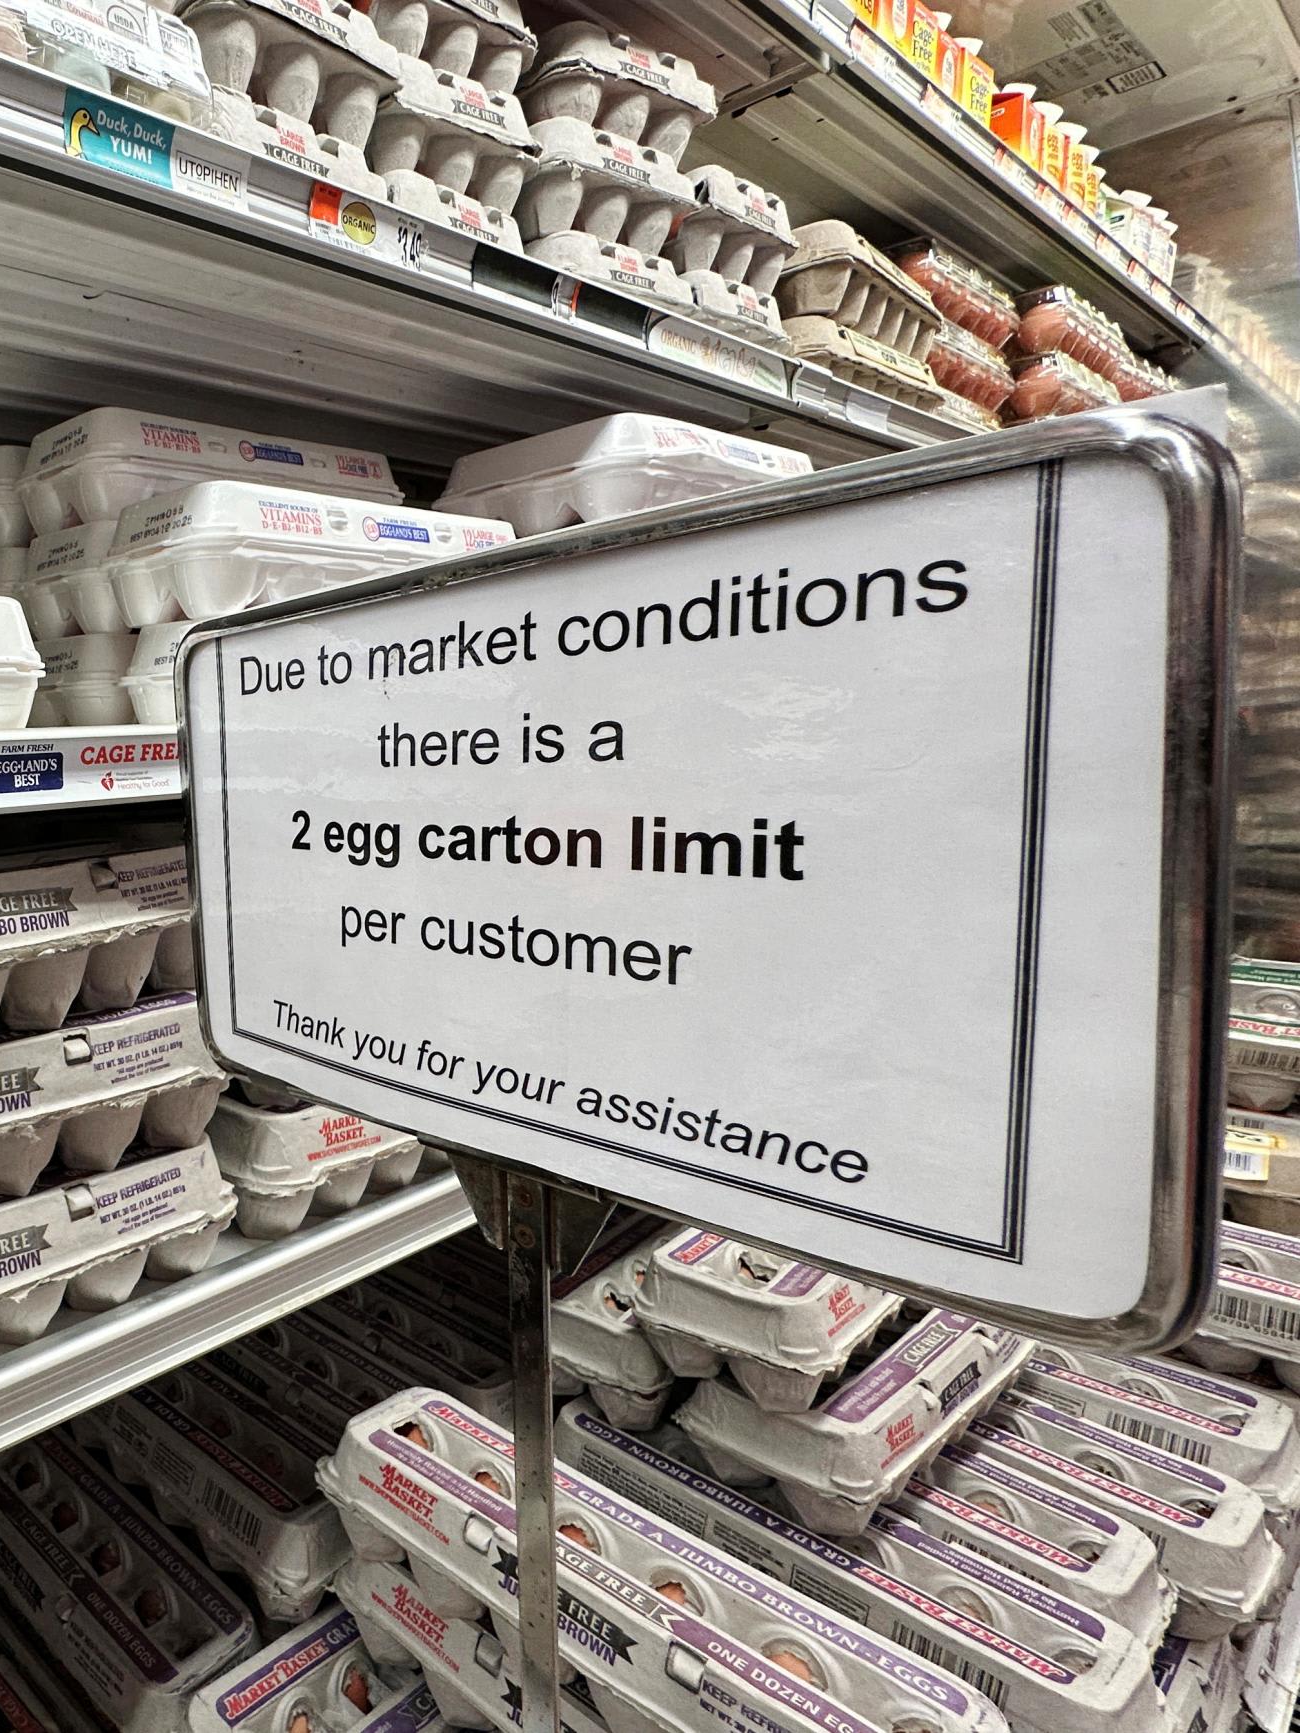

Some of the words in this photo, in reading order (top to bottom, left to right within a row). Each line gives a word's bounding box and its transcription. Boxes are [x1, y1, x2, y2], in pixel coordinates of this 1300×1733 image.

[52, 19, 94, 46] OPEN
[96, 109, 131, 138] Duck,
[134, 122, 167, 150] Duck,
[110, 135, 152, 164] YUM!
[273, 147, 300, 167] CAGE
[301, 158, 323, 176] FREE
[178, 155, 239, 193] UTOPIHEN
[609, 160, 628, 175] CAGE
[629, 167, 645, 180] FREE
[343, 214, 375, 235] ORGANIC
[616, 271, 634, 284] CAGE
[635, 276, 650, 288] FREE
[142, 427, 200, 447] VITAMINS
[260, 508, 322, 526] VITAMINS
[240, 655, 304, 695] Due
[318, 643, 352, 685] to
[369, 612, 537, 680] market
[557, 558, 967, 658] conditions
[1, 745, 25, 754] FARM
[27, 743, 54, 753] FRESH
[80, 745, 135, 766] CAGE
[378, 722, 499, 768] there
[522, 712, 564, 764] is
[588, 719, 625, 763] a
[14, 773, 41, 788] BEST
[291, 811, 311, 851] 2
[324, 823, 400, 869] egg
[417, 816, 601, 869] carton
[631, 817, 804, 881] limit
[18, 891, 58, 912] FREE
[19, 910, 70, 933] BROWN
[341, 905, 405, 948] per
[420, 914, 691, 985] customer
[273, 1000, 345, 1048] Thank
[354, 1032, 406, 1067] you
[415, 1040, 465, 1080] for
[474, 1065, 565, 1107] your
[576, 1085, 869, 1184] assistance
[319, 1115, 363, 1137] MARKET
[96, 1192, 118, 1210] KEEP
[120, 1167, 181, 1201] REFRIGERATED
[380, 1462, 439, 1506] MARKET
[584, 1419, 621, 1446] EGGS
[629, 1444, 690, 1483] BROWN
[692, 1478, 752, 1515] JUMBO
[785, 1526, 850, 1568] GRADE
[555, 1547, 593, 1573] AGE
[597, 1570, 645, 1607] FREE
[578, 1488, 644, 1528] GRADE
[649, 1530, 664, 1545] A
[678, 1545, 758, 1594] JUMBO
[762, 1592, 859, 1650] BROWN
[878, 1655, 949, 1701] EGGS
[392, 1583, 449, 1632] MARKET
[568, 1597, 612, 1638] FREE
[944, 1613, 1067, 1678] MARKET
[225, 1666, 282, 1718] MARKET
[276, 1642, 328, 1682] BASKET
[702, 1679, 738, 1708] KEEP
[707, 1641, 749, 1671] ONE
[751, 1667, 821, 1716] DOZEN
